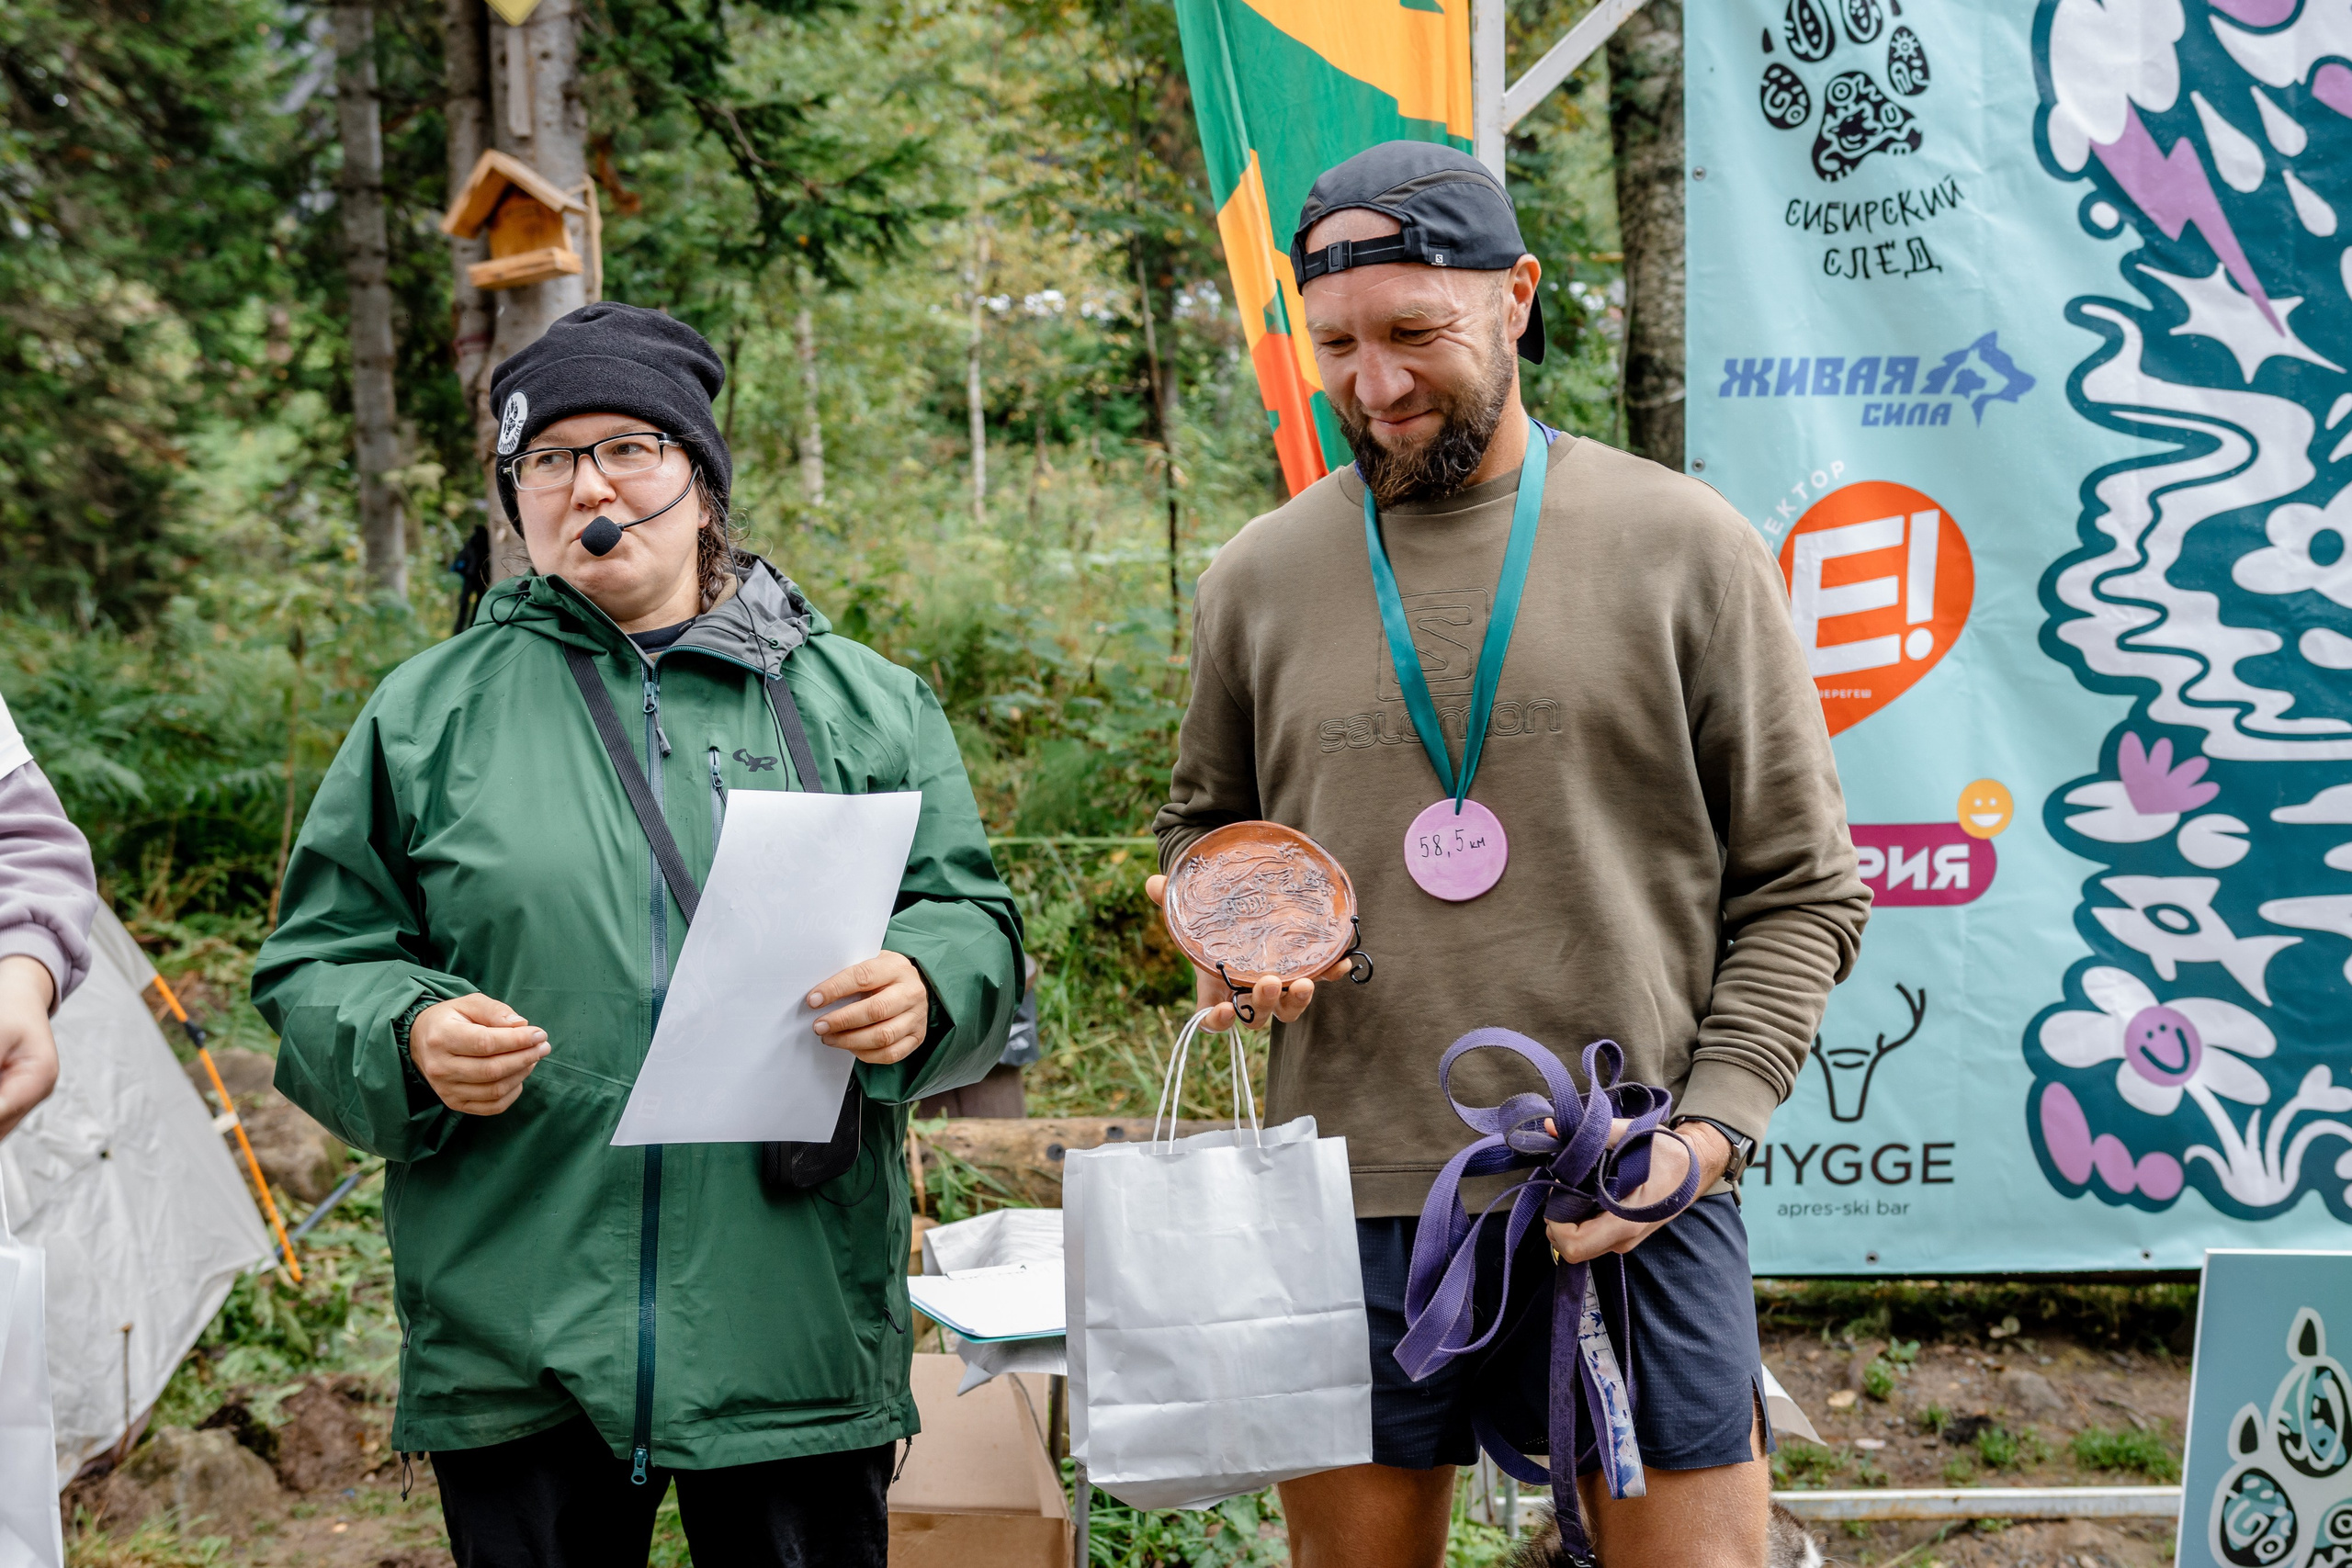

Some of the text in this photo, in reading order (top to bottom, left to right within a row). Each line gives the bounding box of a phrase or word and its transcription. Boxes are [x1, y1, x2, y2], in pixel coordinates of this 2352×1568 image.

[1785, 175, 1964, 234] СИБИРСКИЙ
[1718, 356, 1920, 398] ЖИВАЯ
[1860, 402, 1953, 427] СИЛА
[1763, 459, 1845, 551] ЕКТОР
[1419, 829, 1464, 858] 58,5
[1858, 843, 1970, 891] РИЯ
[1739, 1143, 1955, 1186] HYGGE
[1777, 1200, 1910, 1217] apres-ski bar
